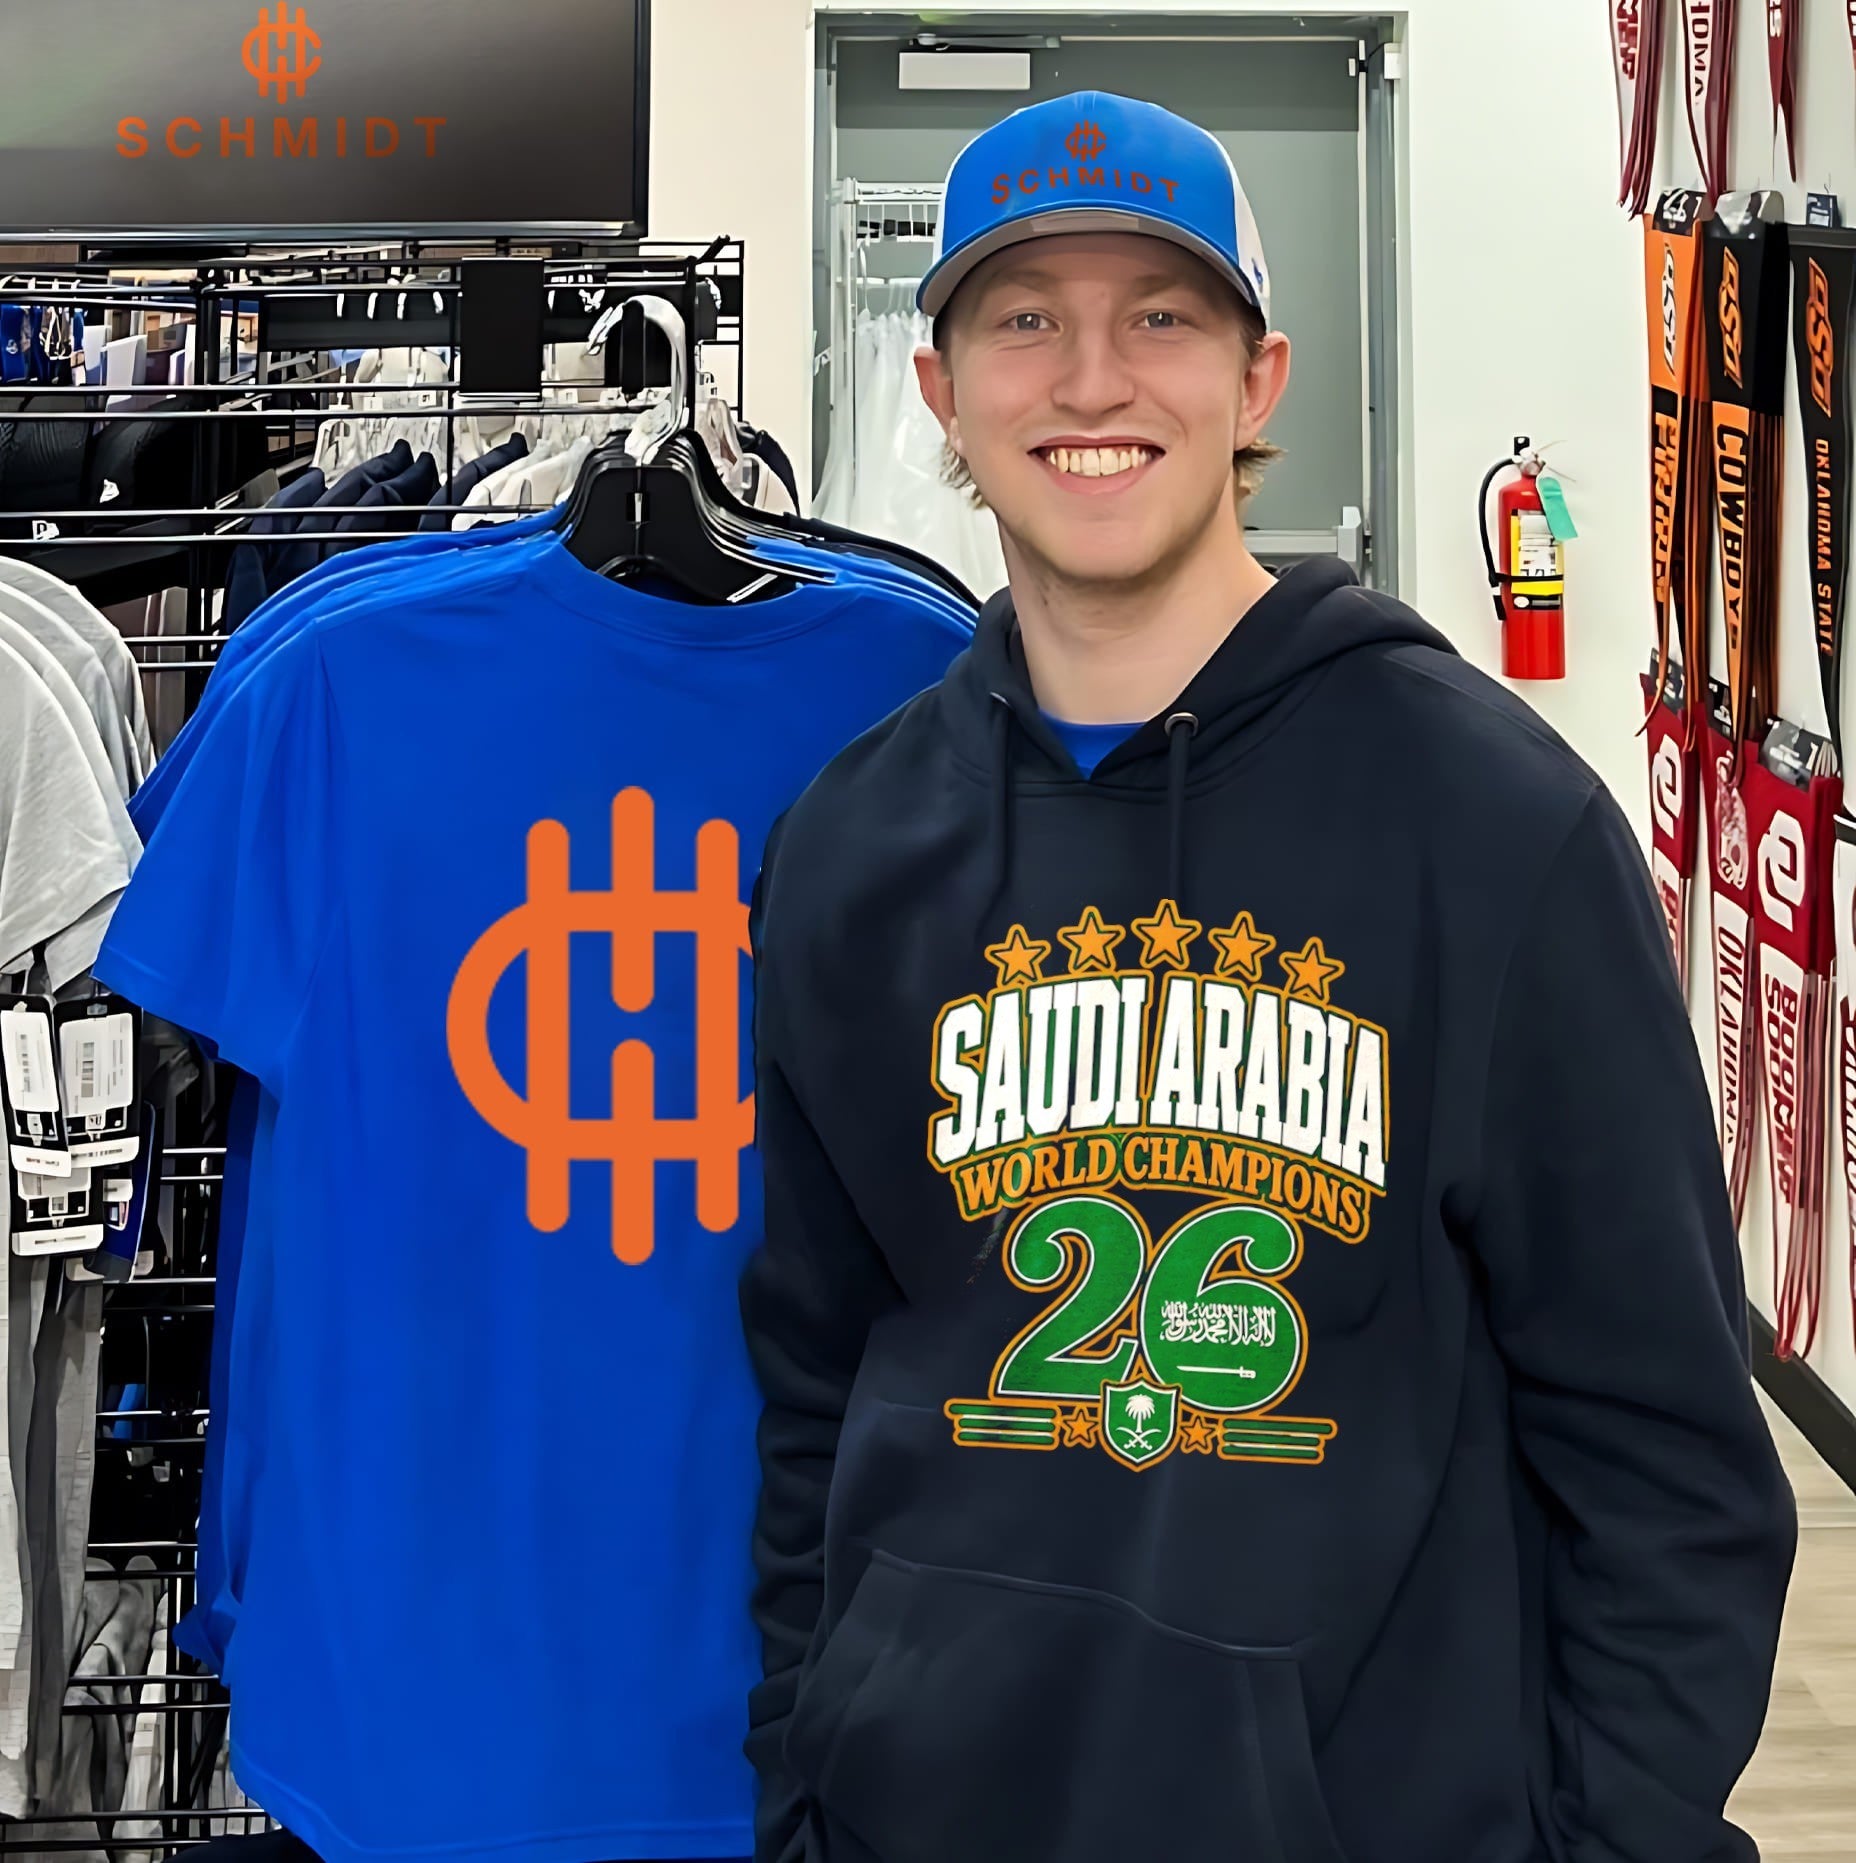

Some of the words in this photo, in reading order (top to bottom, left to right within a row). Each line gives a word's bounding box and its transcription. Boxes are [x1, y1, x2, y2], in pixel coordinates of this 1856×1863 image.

[115, 116, 448, 158] SCHMIDT
[991, 166, 1180, 205] SCHMIDT
[1815, 438, 1832, 570] OKLAHOMA
[1817, 583, 1834, 657] STATE
[934, 977, 1148, 1165] SAUDI
[1150, 977, 1387, 1188] ARABIA
[960, 1138, 1117, 1211] WORLD
[1123, 1136, 1363, 1233] CHAMPIONS
[997, 1196, 1301, 1412] 26
